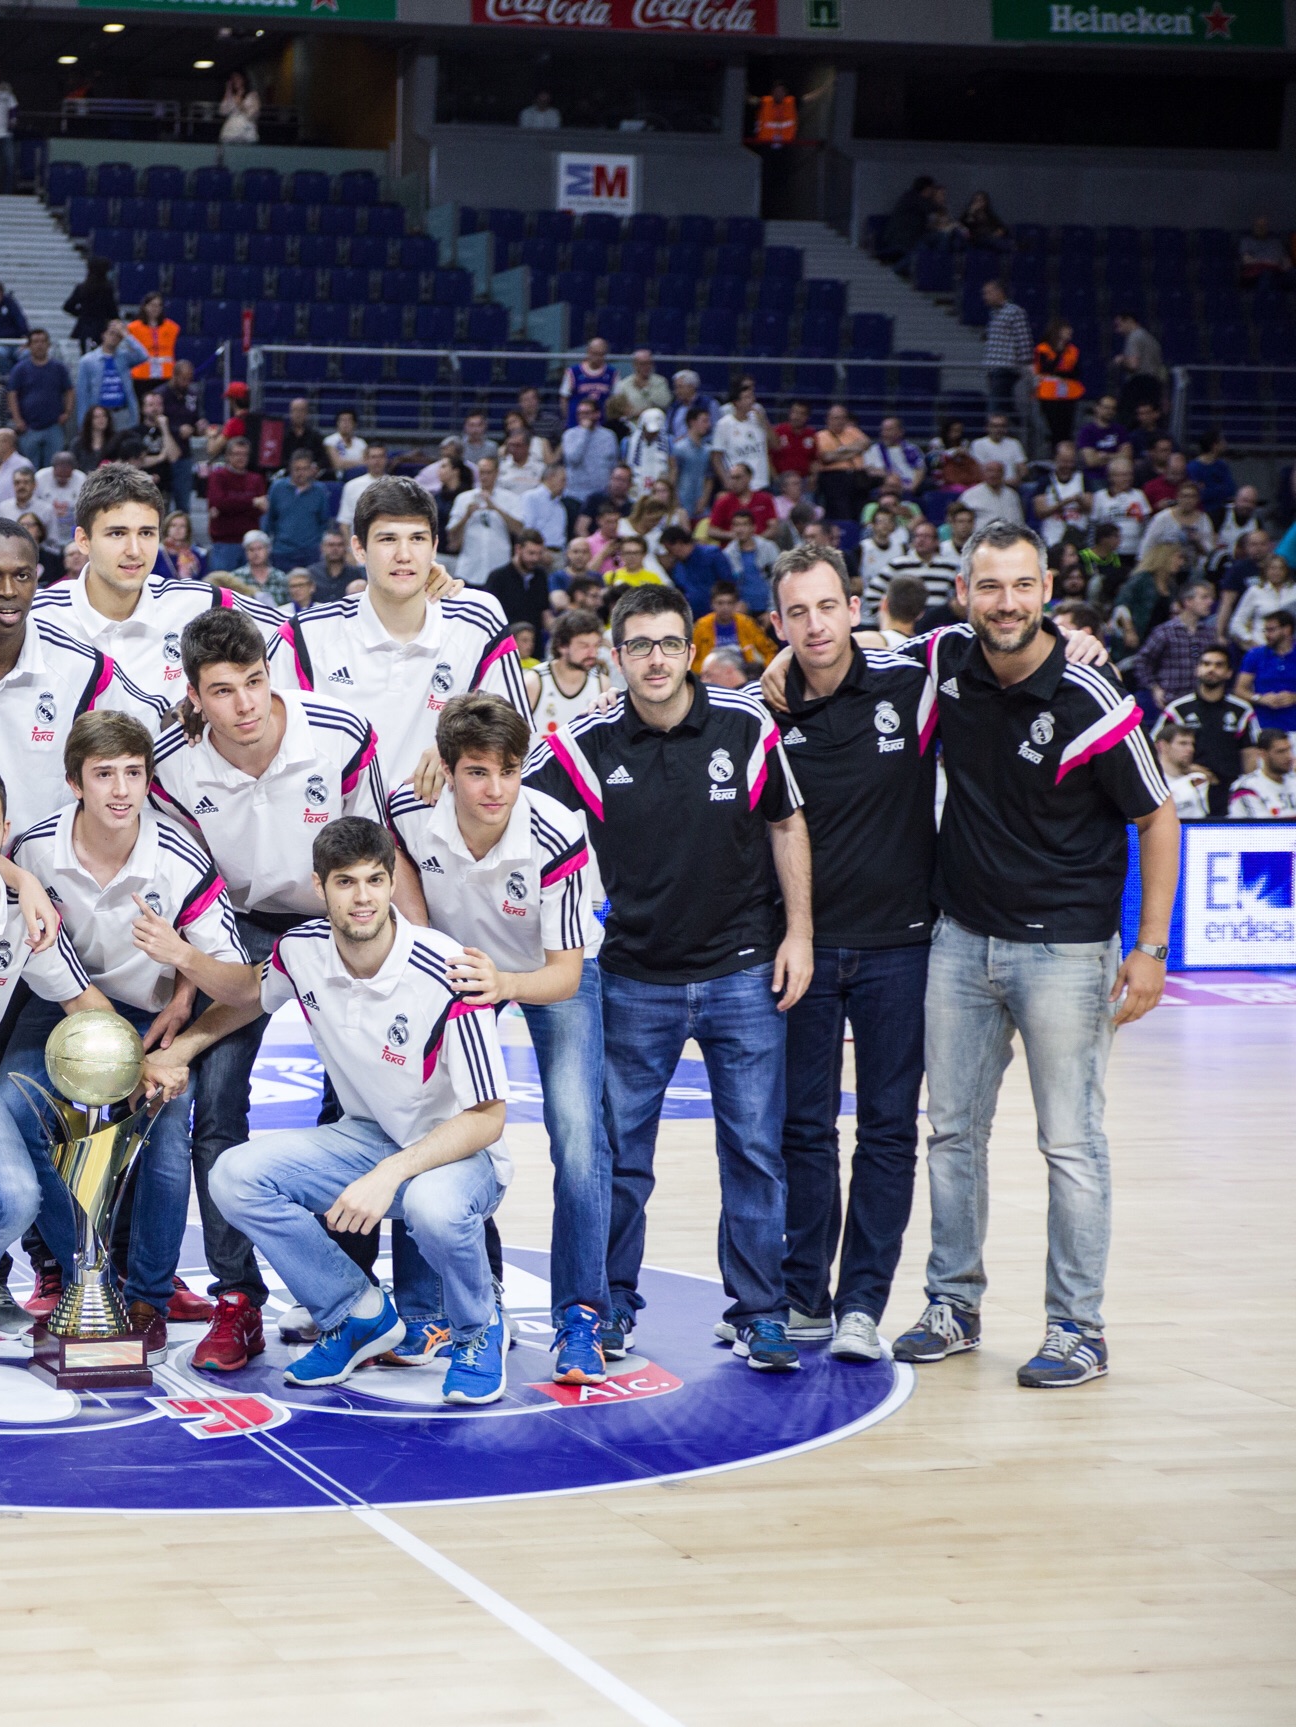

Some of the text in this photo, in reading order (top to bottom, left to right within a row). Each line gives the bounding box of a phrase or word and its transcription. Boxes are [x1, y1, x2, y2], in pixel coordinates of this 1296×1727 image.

[1049, 4, 1195, 35] Heineken
[163, 666, 182, 681] Teka
[328, 675, 354, 685] adidas
[31, 726, 55, 742] Teka
[877, 736, 905, 753] Teka
[709, 784, 737, 801] Teka
[194, 806, 219, 815] adidas
[304, 807, 329, 823] Teka
[420, 864, 445, 875] adidas
[502, 900, 526, 917] Teka
[1206, 916, 1294, 942] endesa
[381, 1045, 406, 1066] Teka
